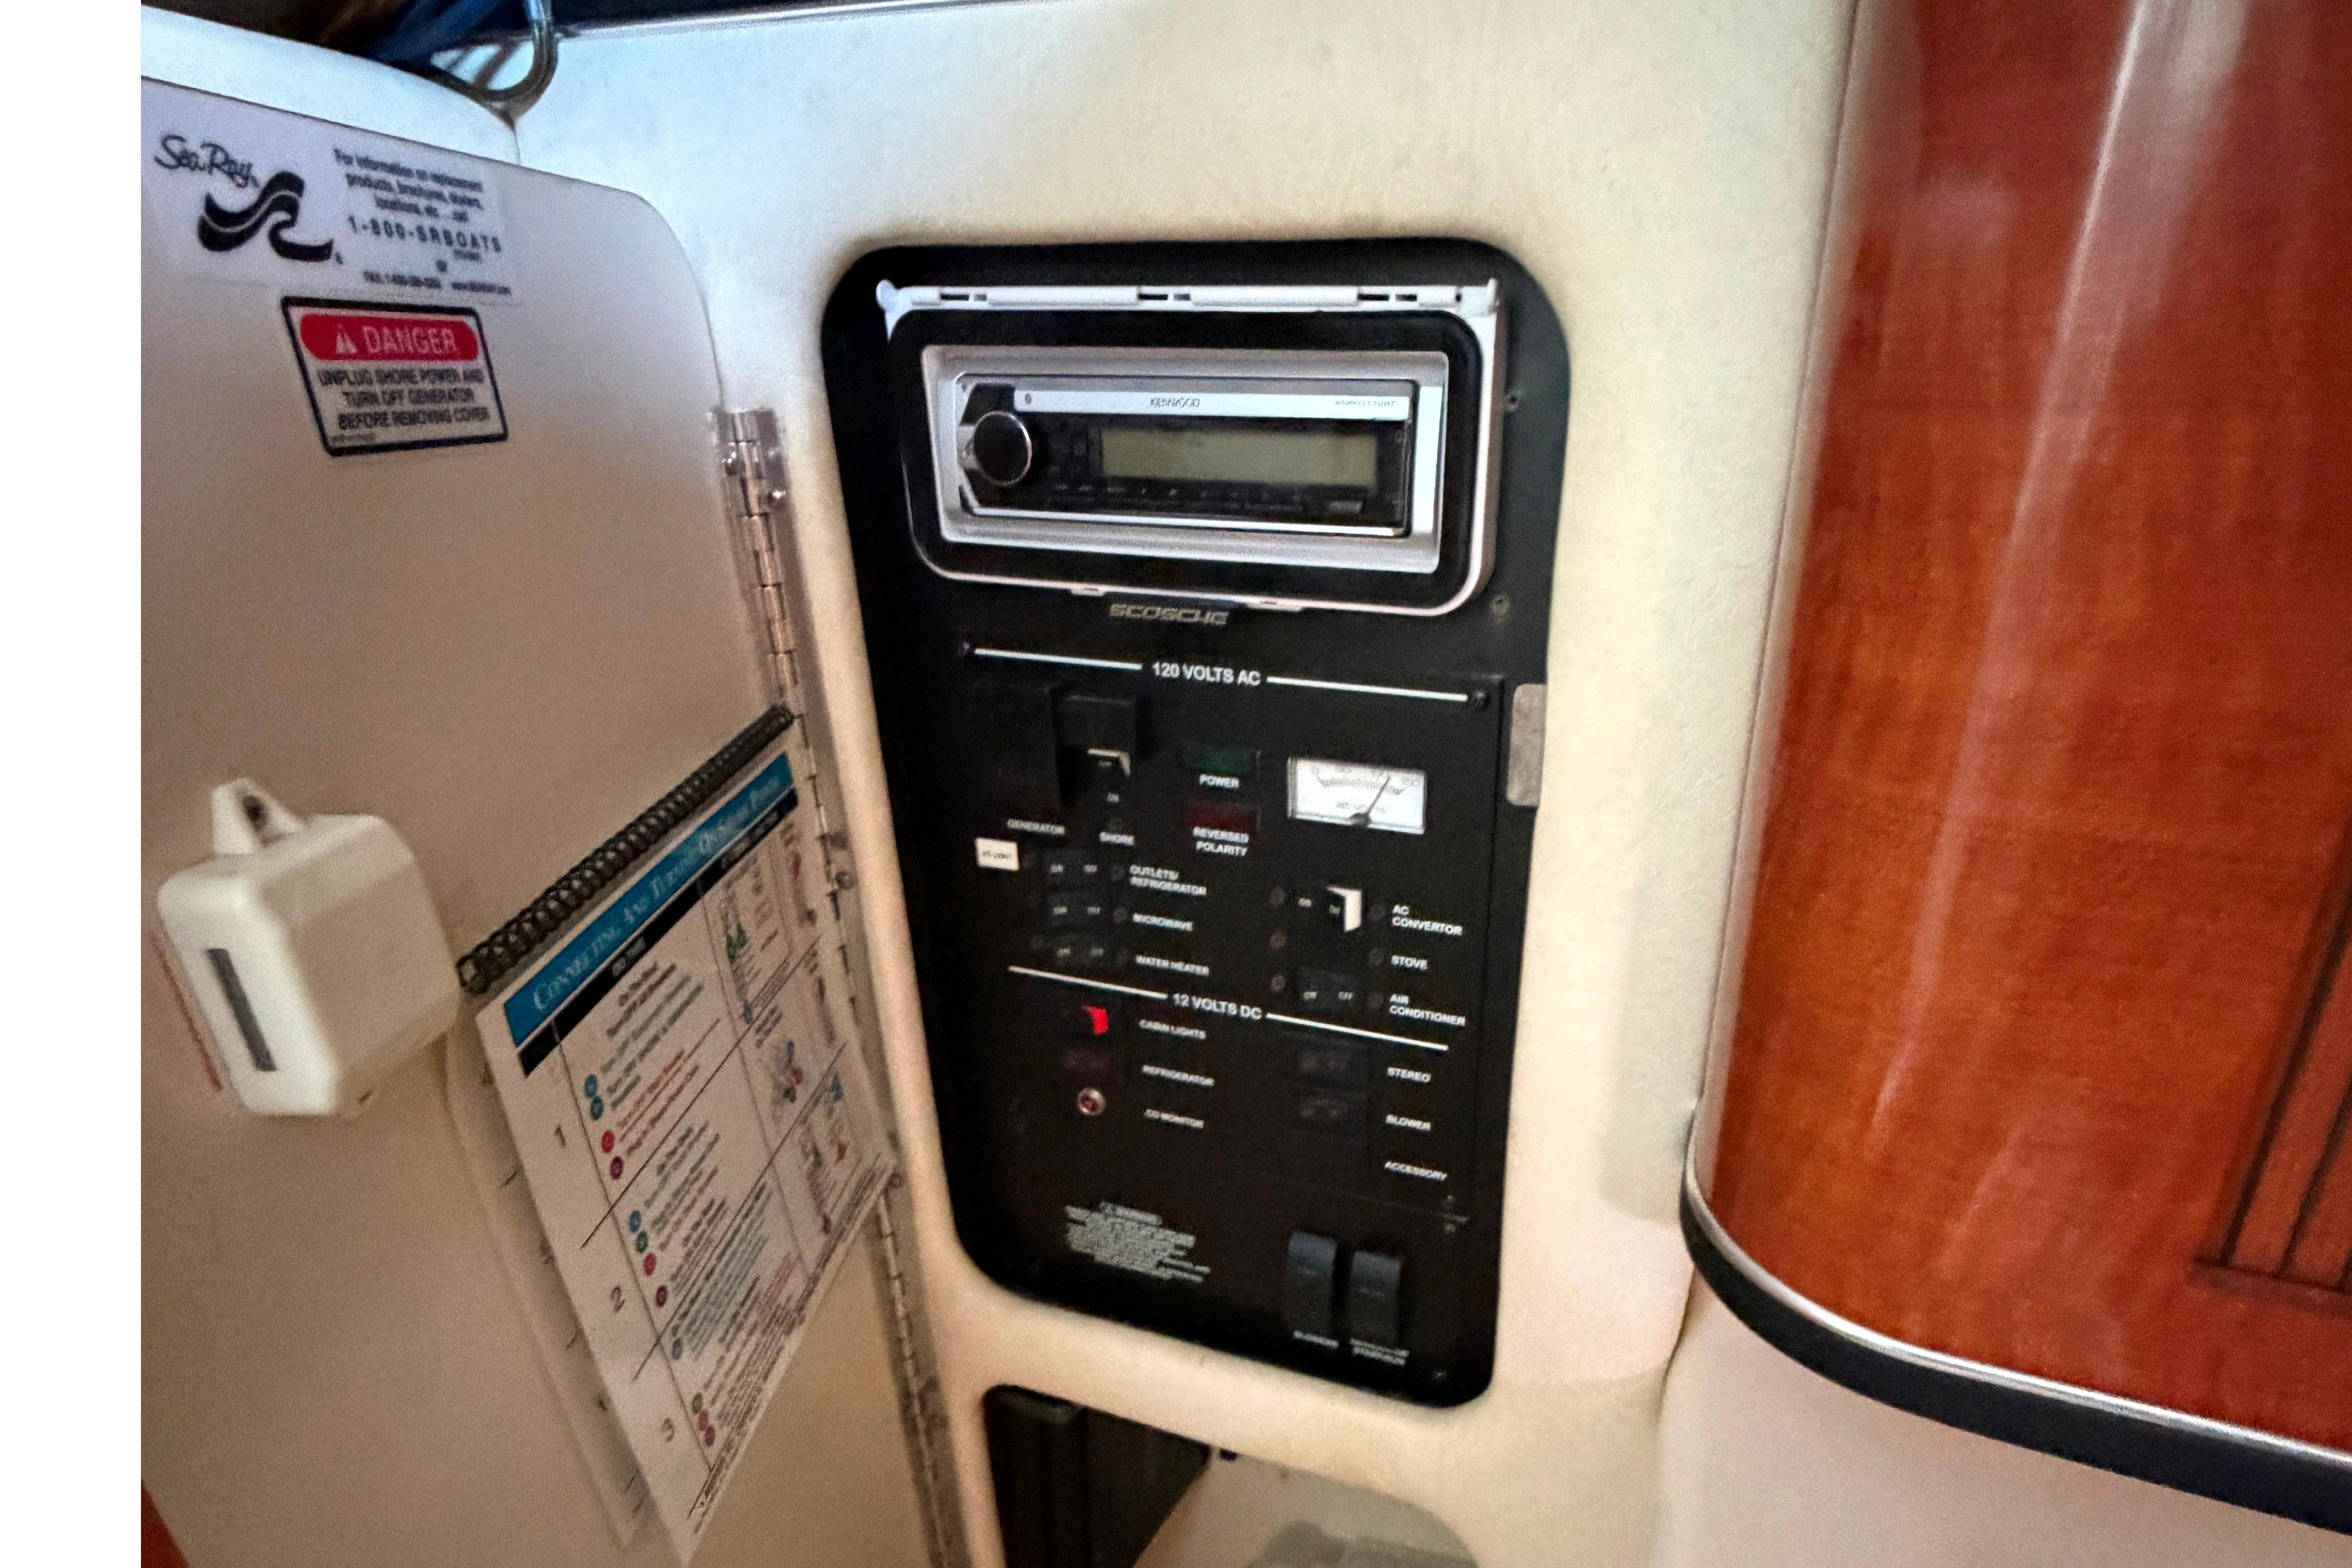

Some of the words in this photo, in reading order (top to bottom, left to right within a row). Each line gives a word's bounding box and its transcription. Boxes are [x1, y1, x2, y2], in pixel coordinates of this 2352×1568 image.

[153, 134, 198, 172] Sea
[199, 142, 254, 189] Ray
[362, 325, 460, 355] DANGER
[318, 368, 373, 386] UNPLUG
[419, 368, 461, 384] POWER
[407, 387, 476, 405] GENERATOR
[339, 411, 389, 430] BEFORE
[1152, 662, 1180, 678] 120
[1182, 663, 1234, 683] VOLTS
[1237, 669, 1261, 686] AC
[1198, 773, 1240, 789] POWER
[1006, 818, 1066, 836] GENERATOR
[1192, 826, 1250, 843] REVERSED
[1098, 832, 1135, 846] SHORE
[1195, 841, 1248, 856] POLARITY
[1130, 876, 1207, 896] REFRIGERATOR
[1392, 904, 1410, 916] AC
[1132, 912, 1193, 932] MICROWAVE
[1392, 915, 1463, 936] CONVERTOR
[1136, 954, 1170, 970] WATER
[1171, 961, 1210, 977] HEATER
[1391, 955, 1428, 971] STOVE
[1173, 993, 1190, 1008] 12
[1191, 996, 1238, 1016] VOLTS
[1240, 1005, 1262, 1020] DC
[1389, 993, 1410, 1006] AIR
[1389, 1004, 1466, 1027] CONDITIONER
[1138, 1019, 1170, 1034] CABIN
[1171, 1024, 1207, 1040] LIGHTS
[1142, 1064, 1215, 1087] REFRIGERATOR
[1387, 1066, 1432, 1084] STEREO
[1385, 1113, 1432, 1132] BLOWER
[1384, 1161, 1448, 1182] ACCESSORY
[610, 1286, 626, 1314] 2
